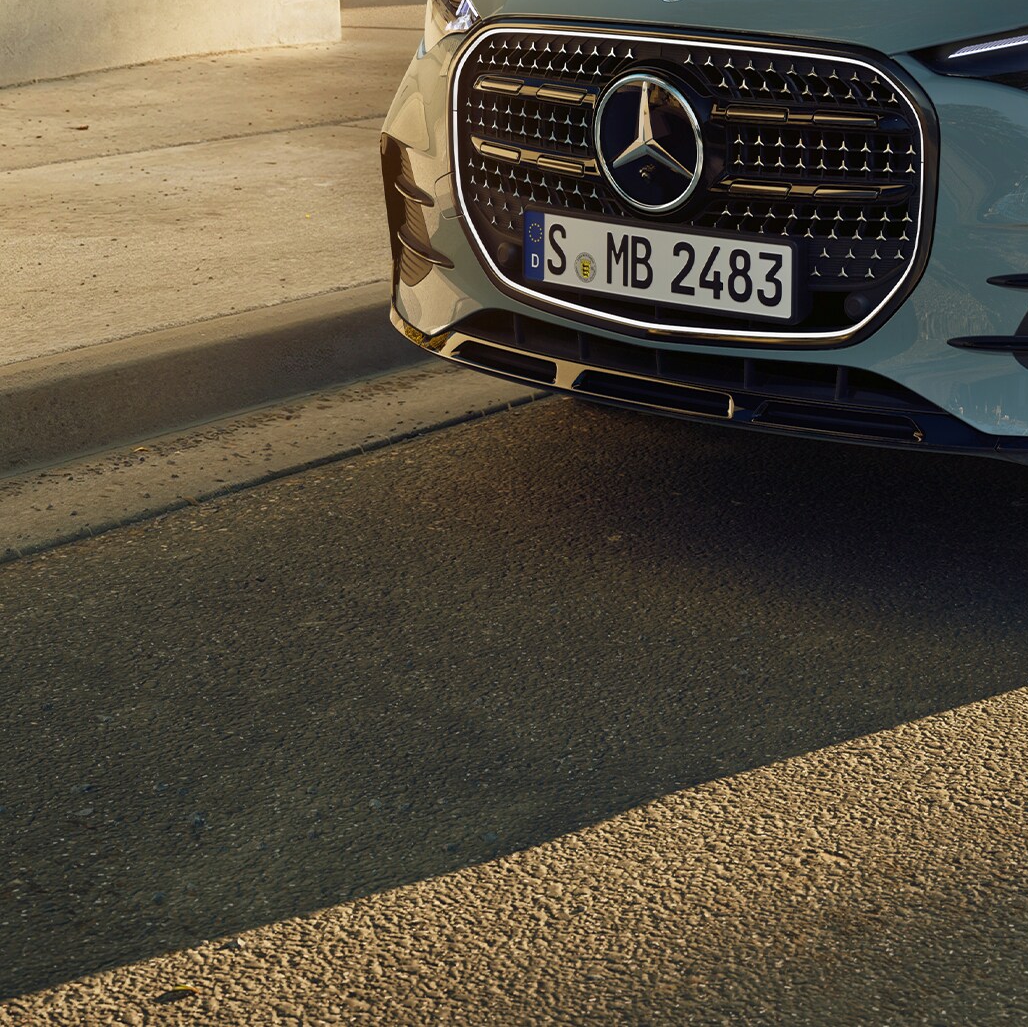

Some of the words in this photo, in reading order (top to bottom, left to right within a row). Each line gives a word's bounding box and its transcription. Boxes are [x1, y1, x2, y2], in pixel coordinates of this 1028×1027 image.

[531, 254, 539, 268] D
[547, 224, 567, 275] S
[606, 232, 653, 289] MB
[670, 241, 783, 307] 2483
